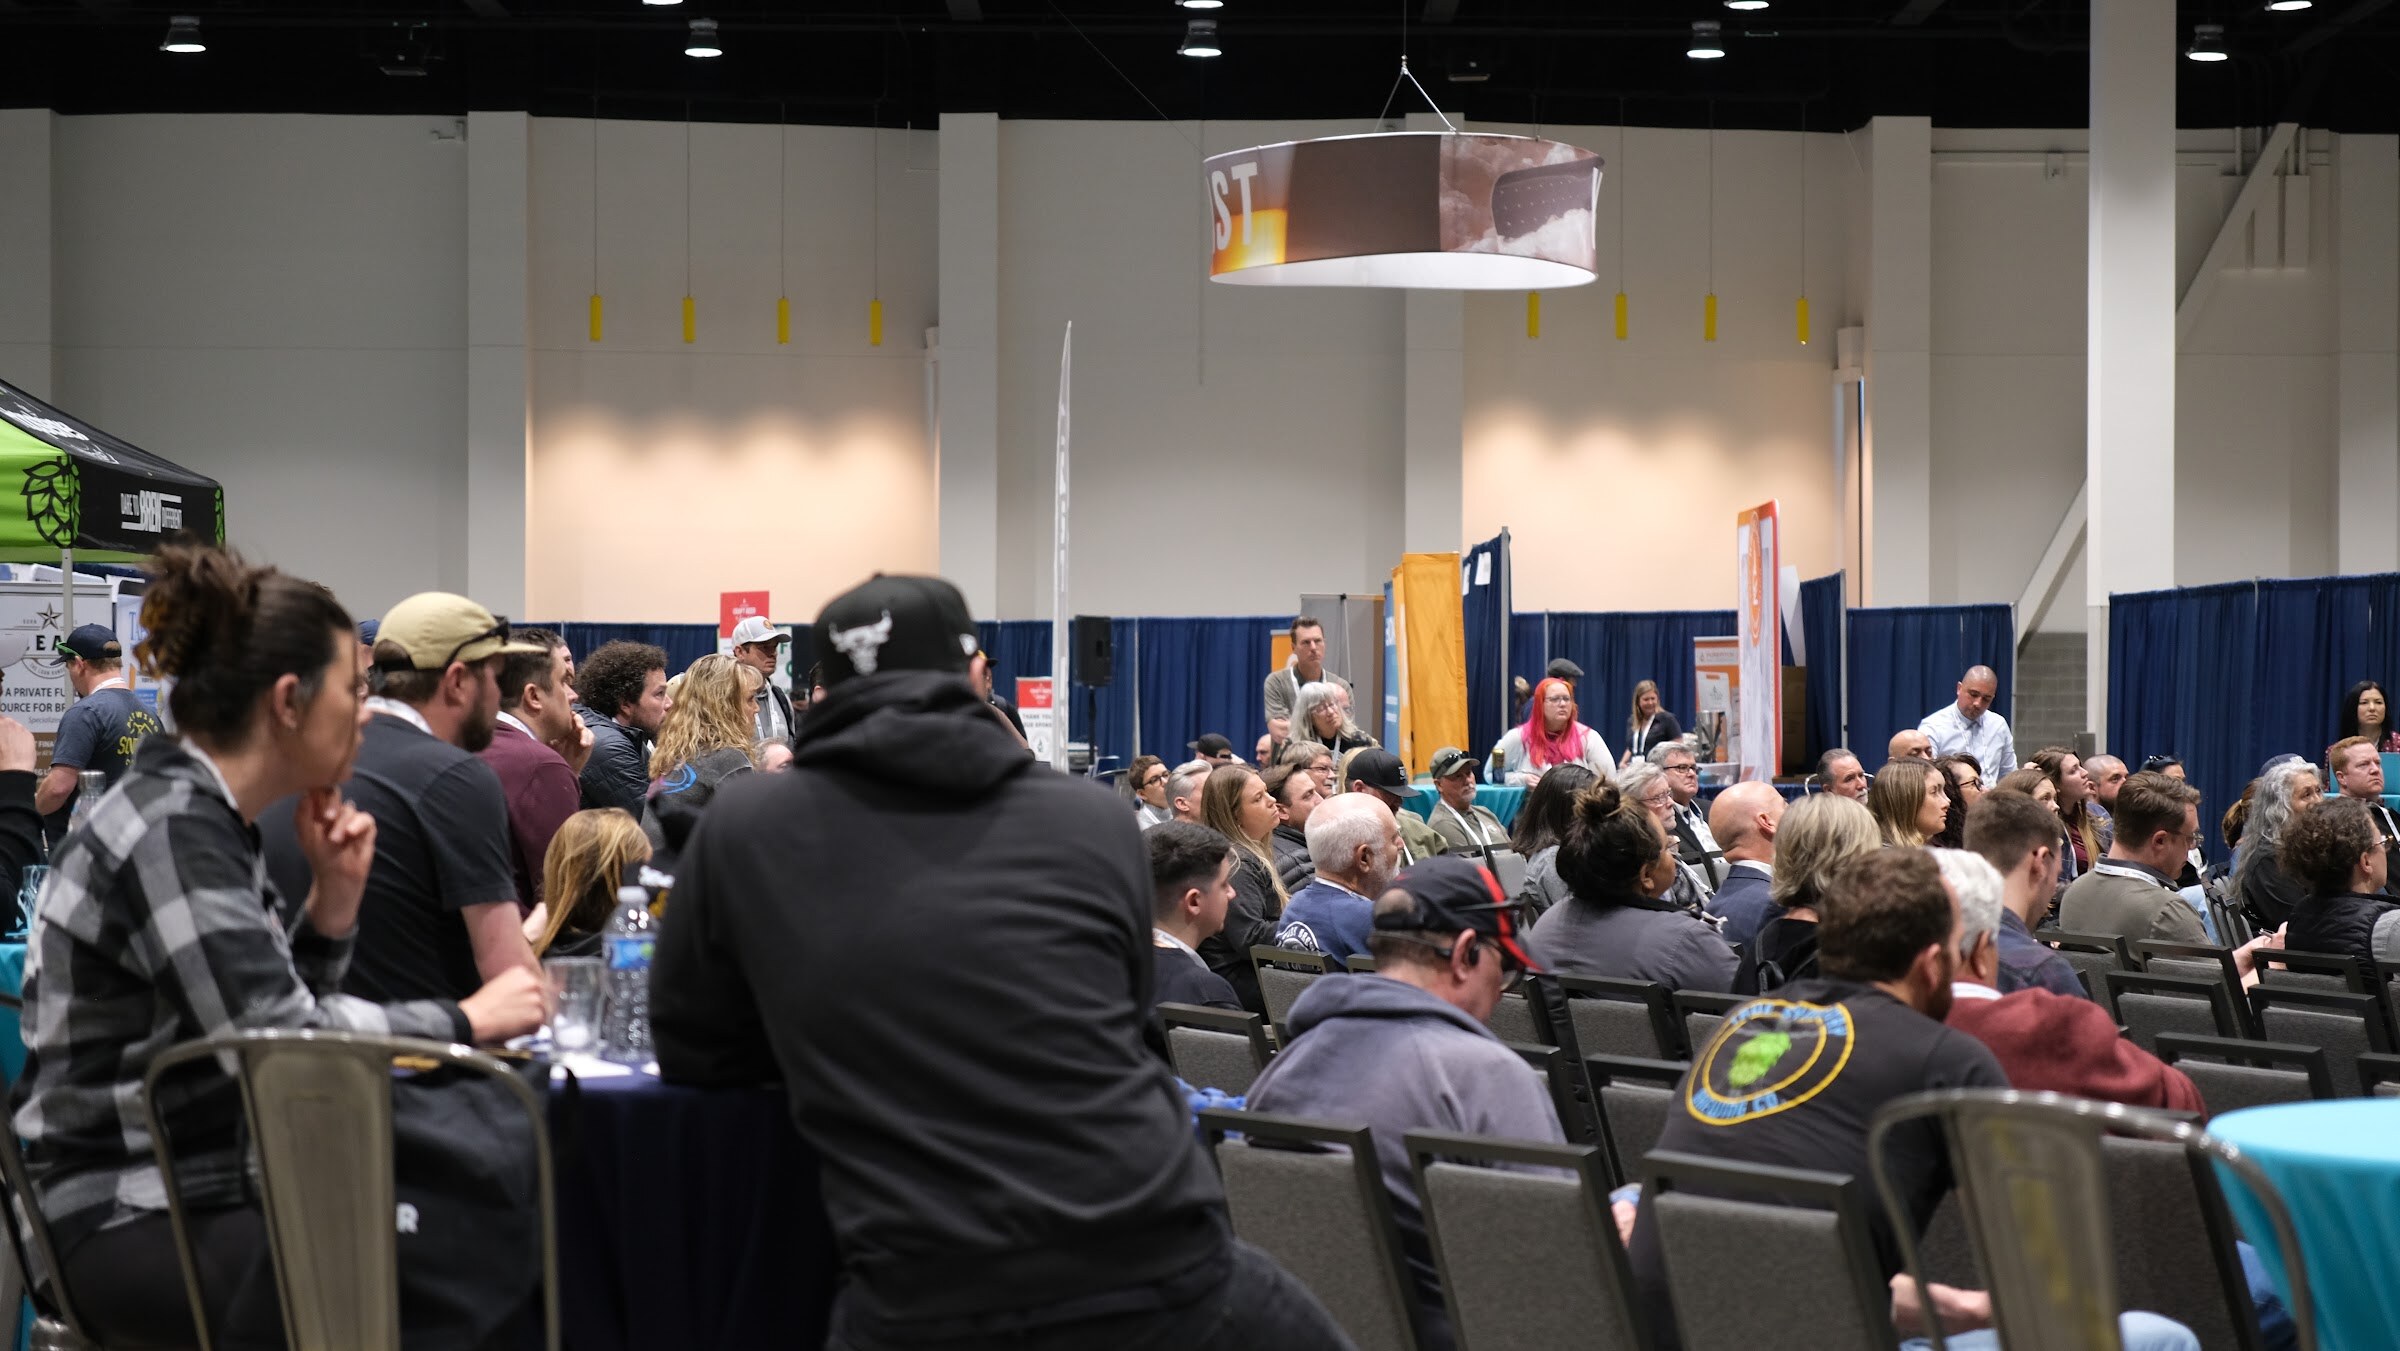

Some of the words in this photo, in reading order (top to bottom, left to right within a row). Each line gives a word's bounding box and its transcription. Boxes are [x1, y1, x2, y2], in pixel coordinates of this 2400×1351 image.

[1206, 161, 1258, 251] ST
[5, 688, 12, 697] A
[14, 688, 53, 697] PRIVATE
[0, 703, 31, 712] OURCE
[33, 703, 53, 712] FOR
[395, 1201, 420, 1234] R
